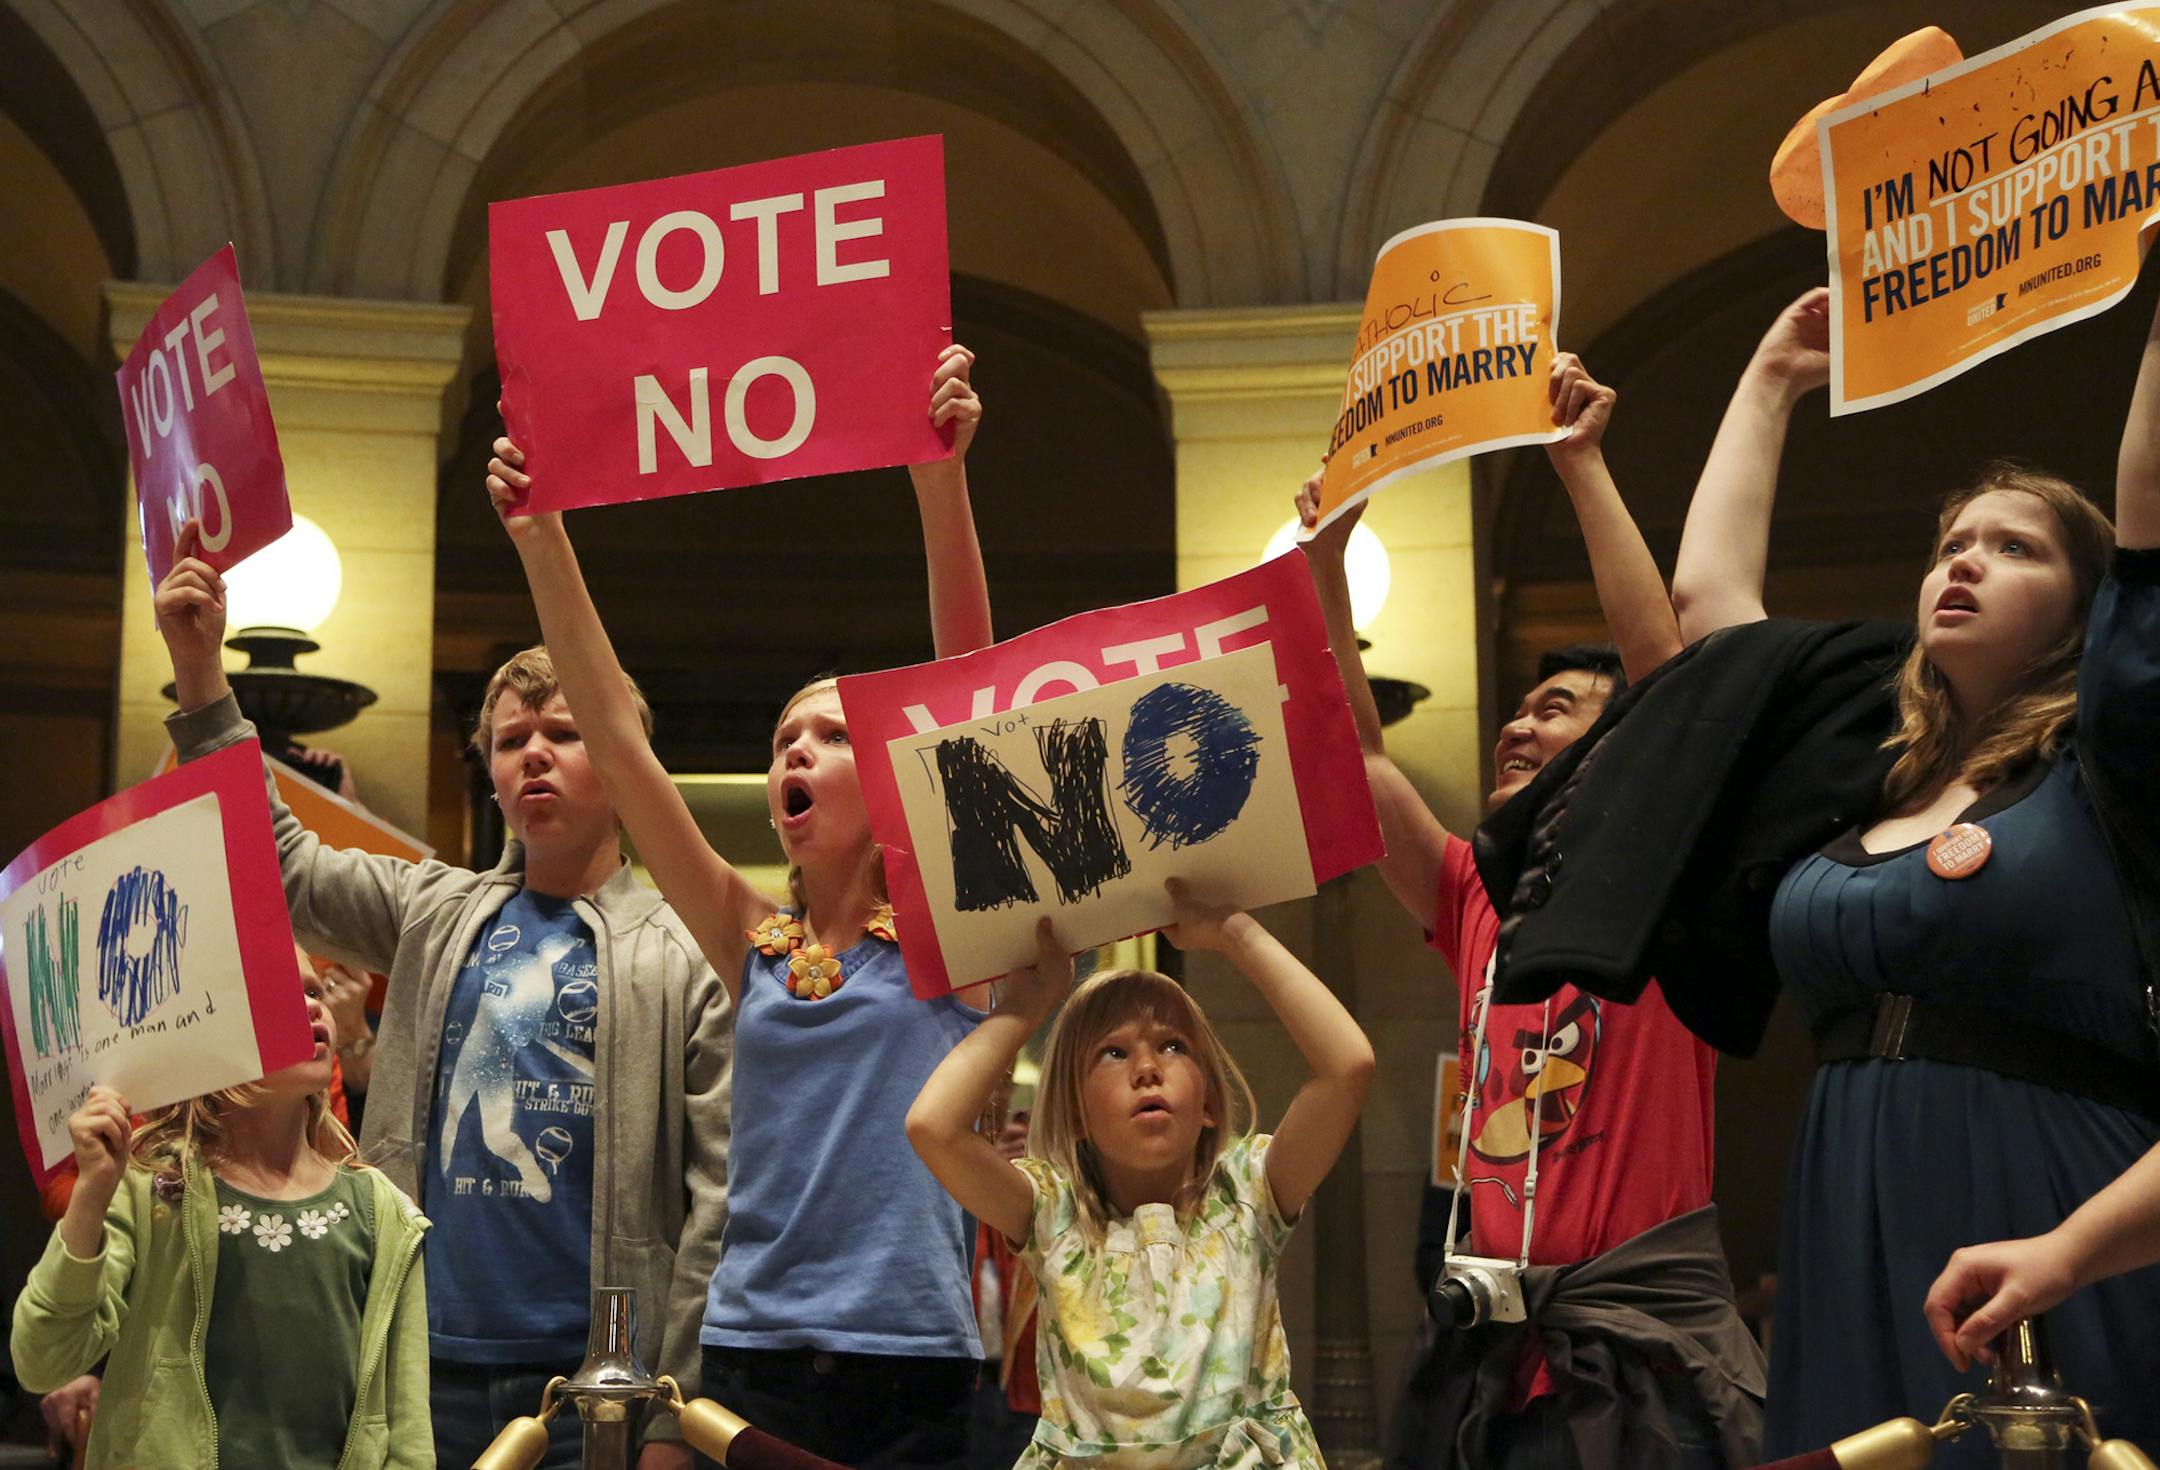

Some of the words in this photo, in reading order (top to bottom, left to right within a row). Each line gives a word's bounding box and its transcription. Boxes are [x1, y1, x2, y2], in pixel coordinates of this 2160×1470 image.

[1862, 172, 1915, 231] I'M
[1928, 131, 1999, 199] NOT
[2009, 76, 2119, 165] GOING
[1862, 212, 1933, 278] AND
[1945, 200, 1958, 247] I
[1968, 121, 2138, 237] SUPPORT
[545, 179, 890, 322] VOTE
[1863, 217, 2021, 324] FREEDOM
[2030, 194, 2070, 250] TO
[2019, 253, 2102, 297] MNUNITED.ORG
[131, 293, 236, 459] VOTE
[1353, 316, 1465, 400] SUPPORT
[1473, 307, 1538, 347] THE
[1389, 369, 1418, 411] TO
[1427, 343, 1537, 397] MARRY
[634, 355, 817, 476] NO
[1386, 414, 1443, 448] MNUNITED.ORG
[915, 682, 1265, 912] NO
[24, 865, 189, 1060] NO
[94, 1033, 119, 1054] one
[131, 1020, 167, 1040] man
[176, 991, 216, 1029] and
[524, 1098, 569, 1114] STRIKE
[566, 1085, 594, 1105] RU
[454, 1177, 476, 1195] HIT
